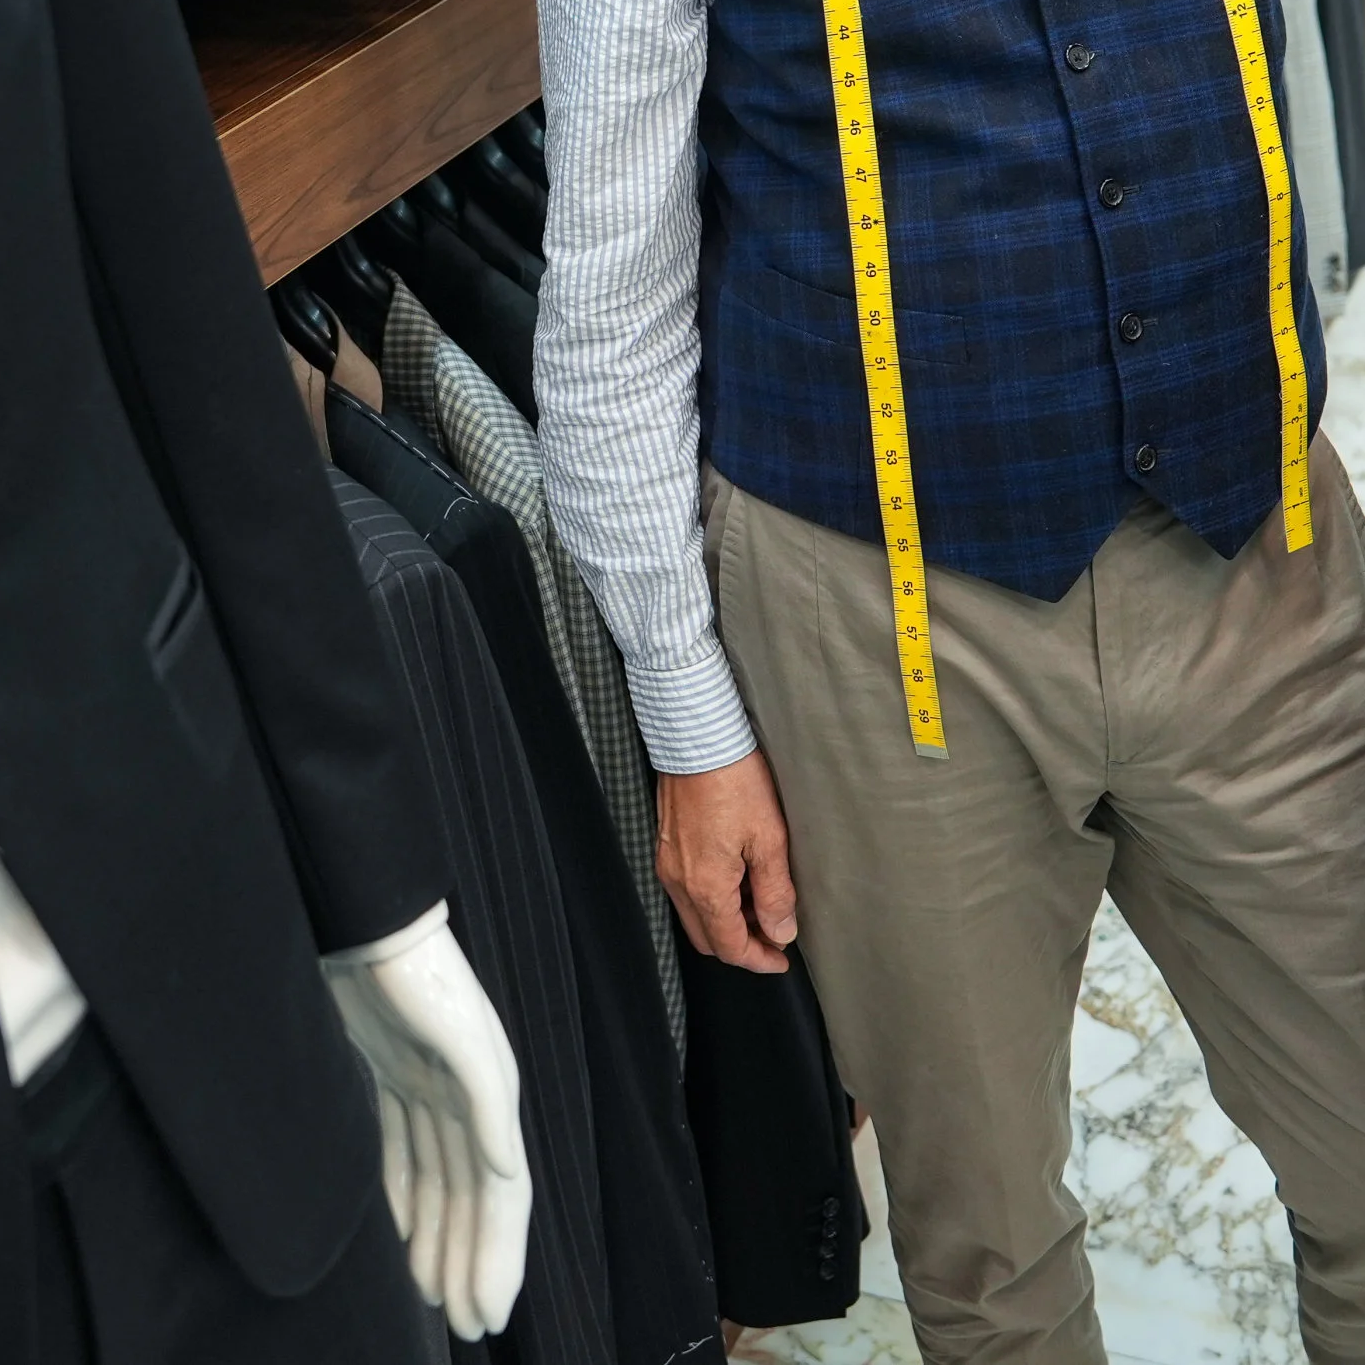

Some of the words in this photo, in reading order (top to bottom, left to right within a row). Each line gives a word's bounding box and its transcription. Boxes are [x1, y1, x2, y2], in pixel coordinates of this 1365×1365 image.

[1237, 2, 1248, 19] 12
[838, 24, 850, 41] 44
[1247, 50, 1258, 65] 11
[844, 71, 856, 88] 45
[1256, 96, 1265, 112] 10
[849, 119, 862, 136] 46
[1267, 146, 1275, 155] 9
[855, 167, 867, 183] 47
[1276, 192, 1284, 201] 8
[860, 214, 872, 230] 48
[865, 262, 877, 278] 49
[1276, 282, 1284, 291] 6
[869, 310, 881, 326] 50
[1280, 327, 1289, 335] 5
[874, 357, 886, 371] 51
[1290, 372, 1298, 381] 4
[881, 402, 893, 418] 52
[1291, 416, 1300, 425] 3
[885, 449, 897, 466] 53
[1290, 458, 1299, 467] 2
[890, 496, 902, 511] 54
[897, 538, 909, 552] 55
[902, 580, 914, 596] 56
[906, 626, 917, 641] 57
[912, 668, 924, 683] 58
[918, 709, 930, 724] 59
